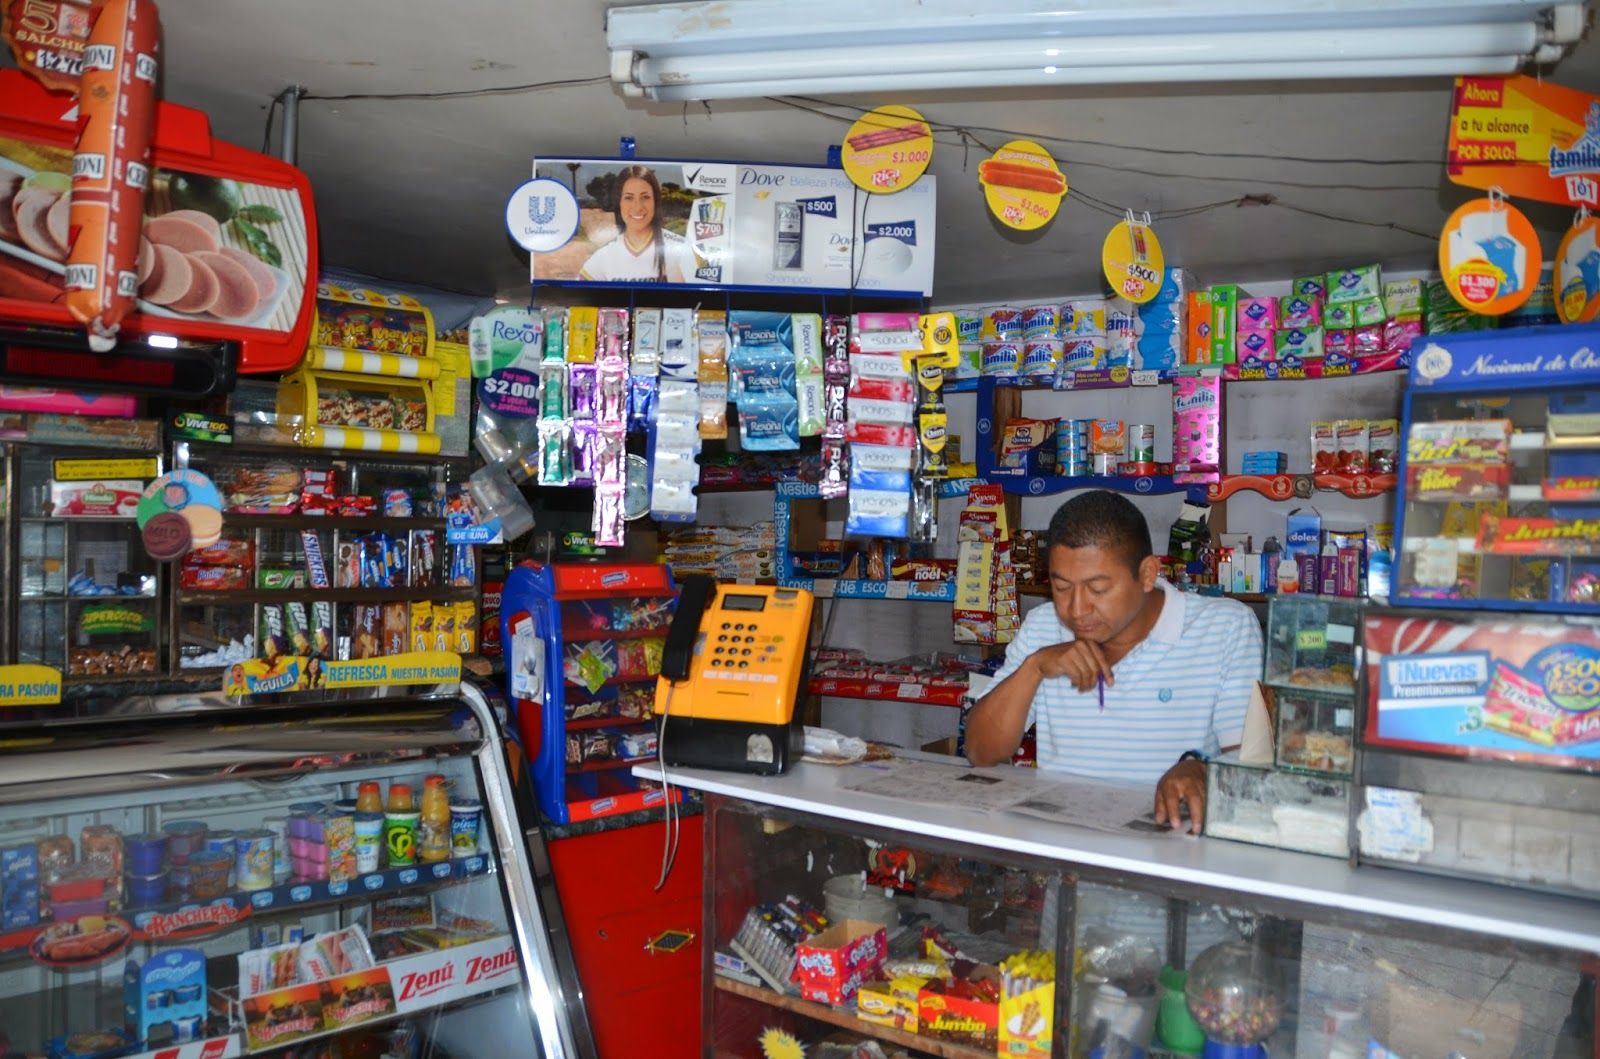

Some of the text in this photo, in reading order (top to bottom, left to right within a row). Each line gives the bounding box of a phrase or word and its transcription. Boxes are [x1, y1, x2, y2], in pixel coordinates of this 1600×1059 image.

[1464, 83, 1499, 101] Ahora
[1461, 117, 1530, 134] a tu alcance
[1458, 144, 1480, 160] POR
[700, 175, 726, 185] Rexona
[741, 167, 785, 186] Dove
[808, 201, 834, 212] $500
[524, 226, 560, 236] Unilever
[696, 222, 722, 236] $700
[878, 226, 913, 238] $2.000
[744, 330, 777, 341] Rexona
[836, 325, 848, 360] AXE
[1461, 354, 1544, 377] Nacional
[748, 376, 780, 386] Rexona
[750, 421, 782, 431] Rexona
[1291, 532, 1318, 542] dolex
[304, 535, 328, 586] SNICKERS
[915, 567, 941, 581] noel
[328, 664, 388, 682] REFRESCA
[391, 667, 428, 679] NUESTRA
[18, 681, 58, 697] PASIÓN
[466, 947, 517, 984] Zenú
[400, 962, 455, 1001] Zenú
[929, 1015, 986, 1032] Jumbo
